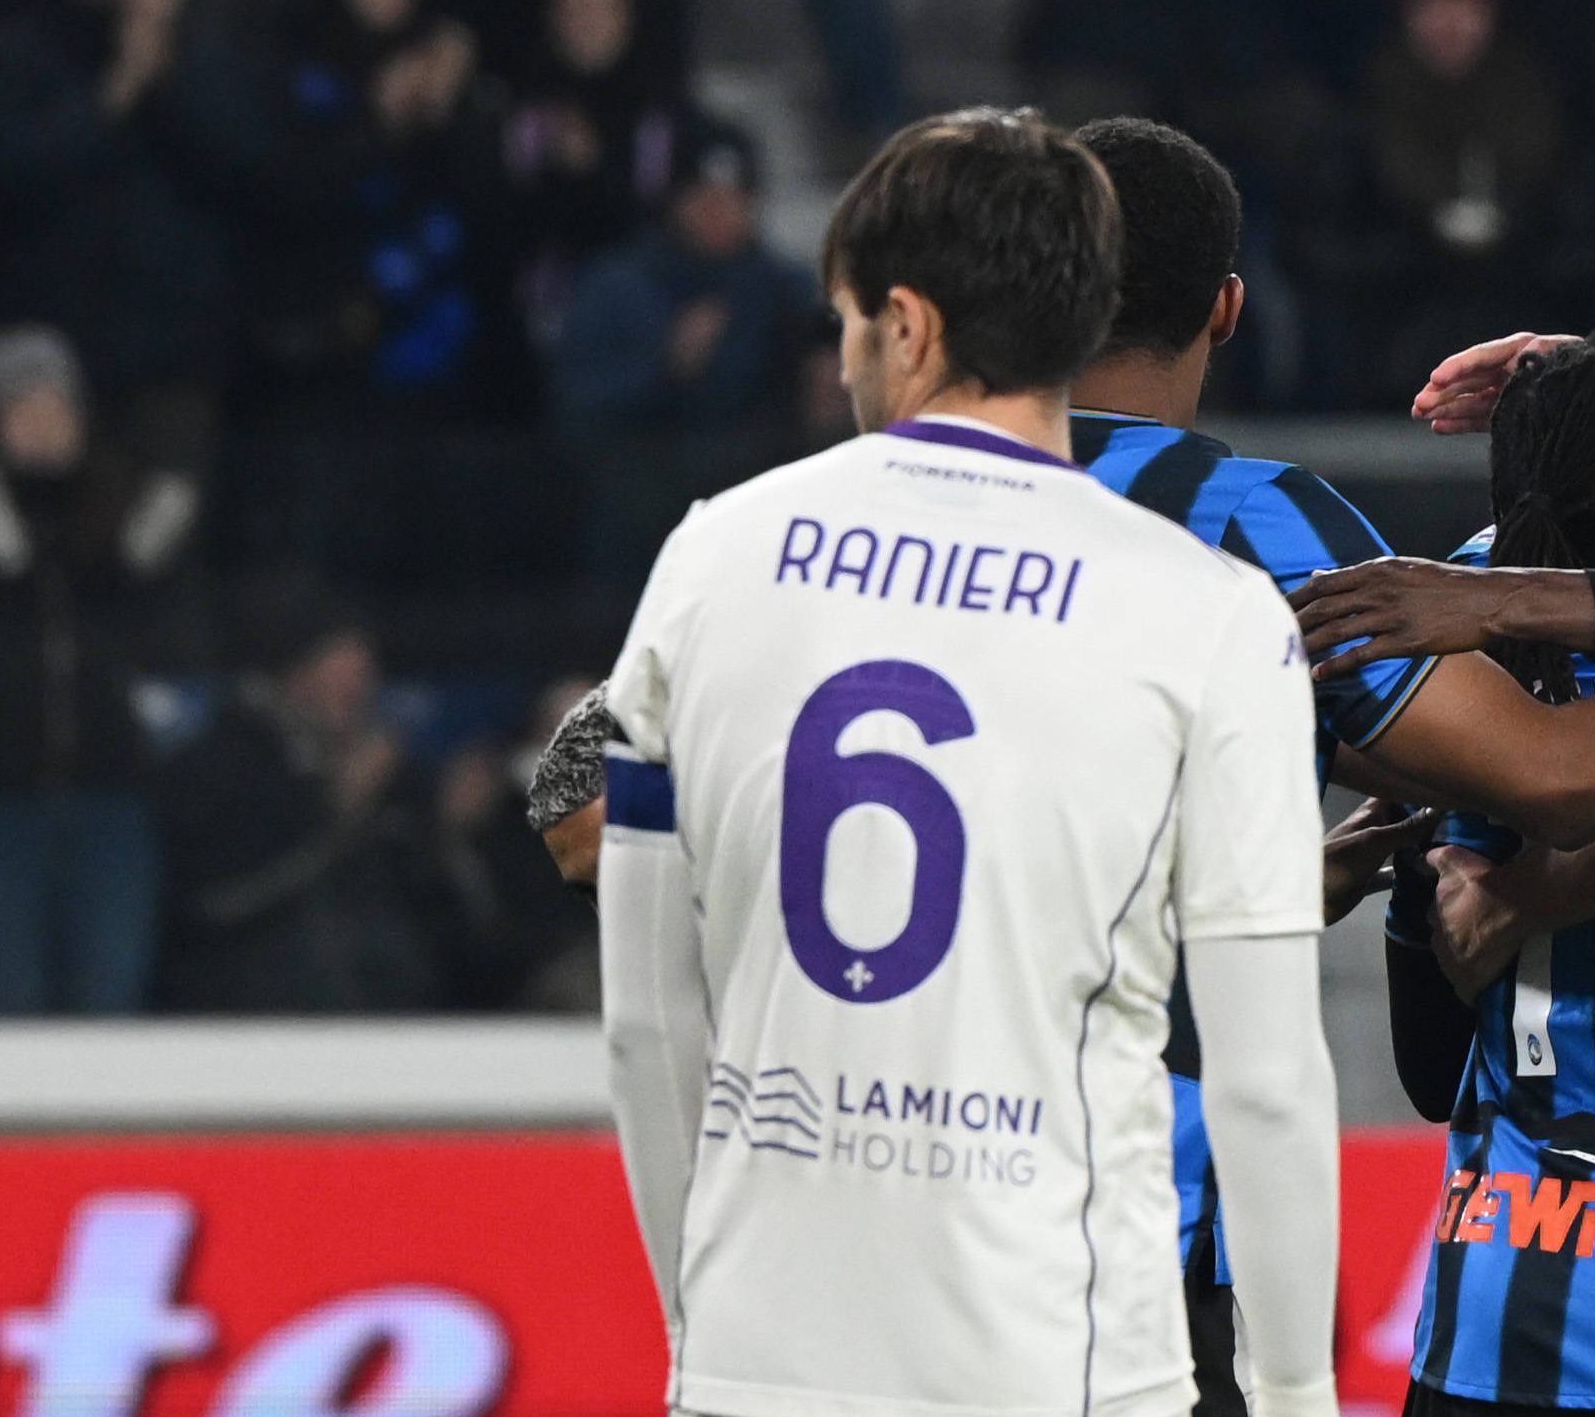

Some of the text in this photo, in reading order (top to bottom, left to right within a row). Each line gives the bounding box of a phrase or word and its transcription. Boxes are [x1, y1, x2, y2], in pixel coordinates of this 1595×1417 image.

[776, 516, 1083, 624] RANIERI
[779, 657, 977, 1006] 6
[834, 1071, 1044, 1137] LAMIONI
[828, 1133, 1038, 1189] HOLDING
